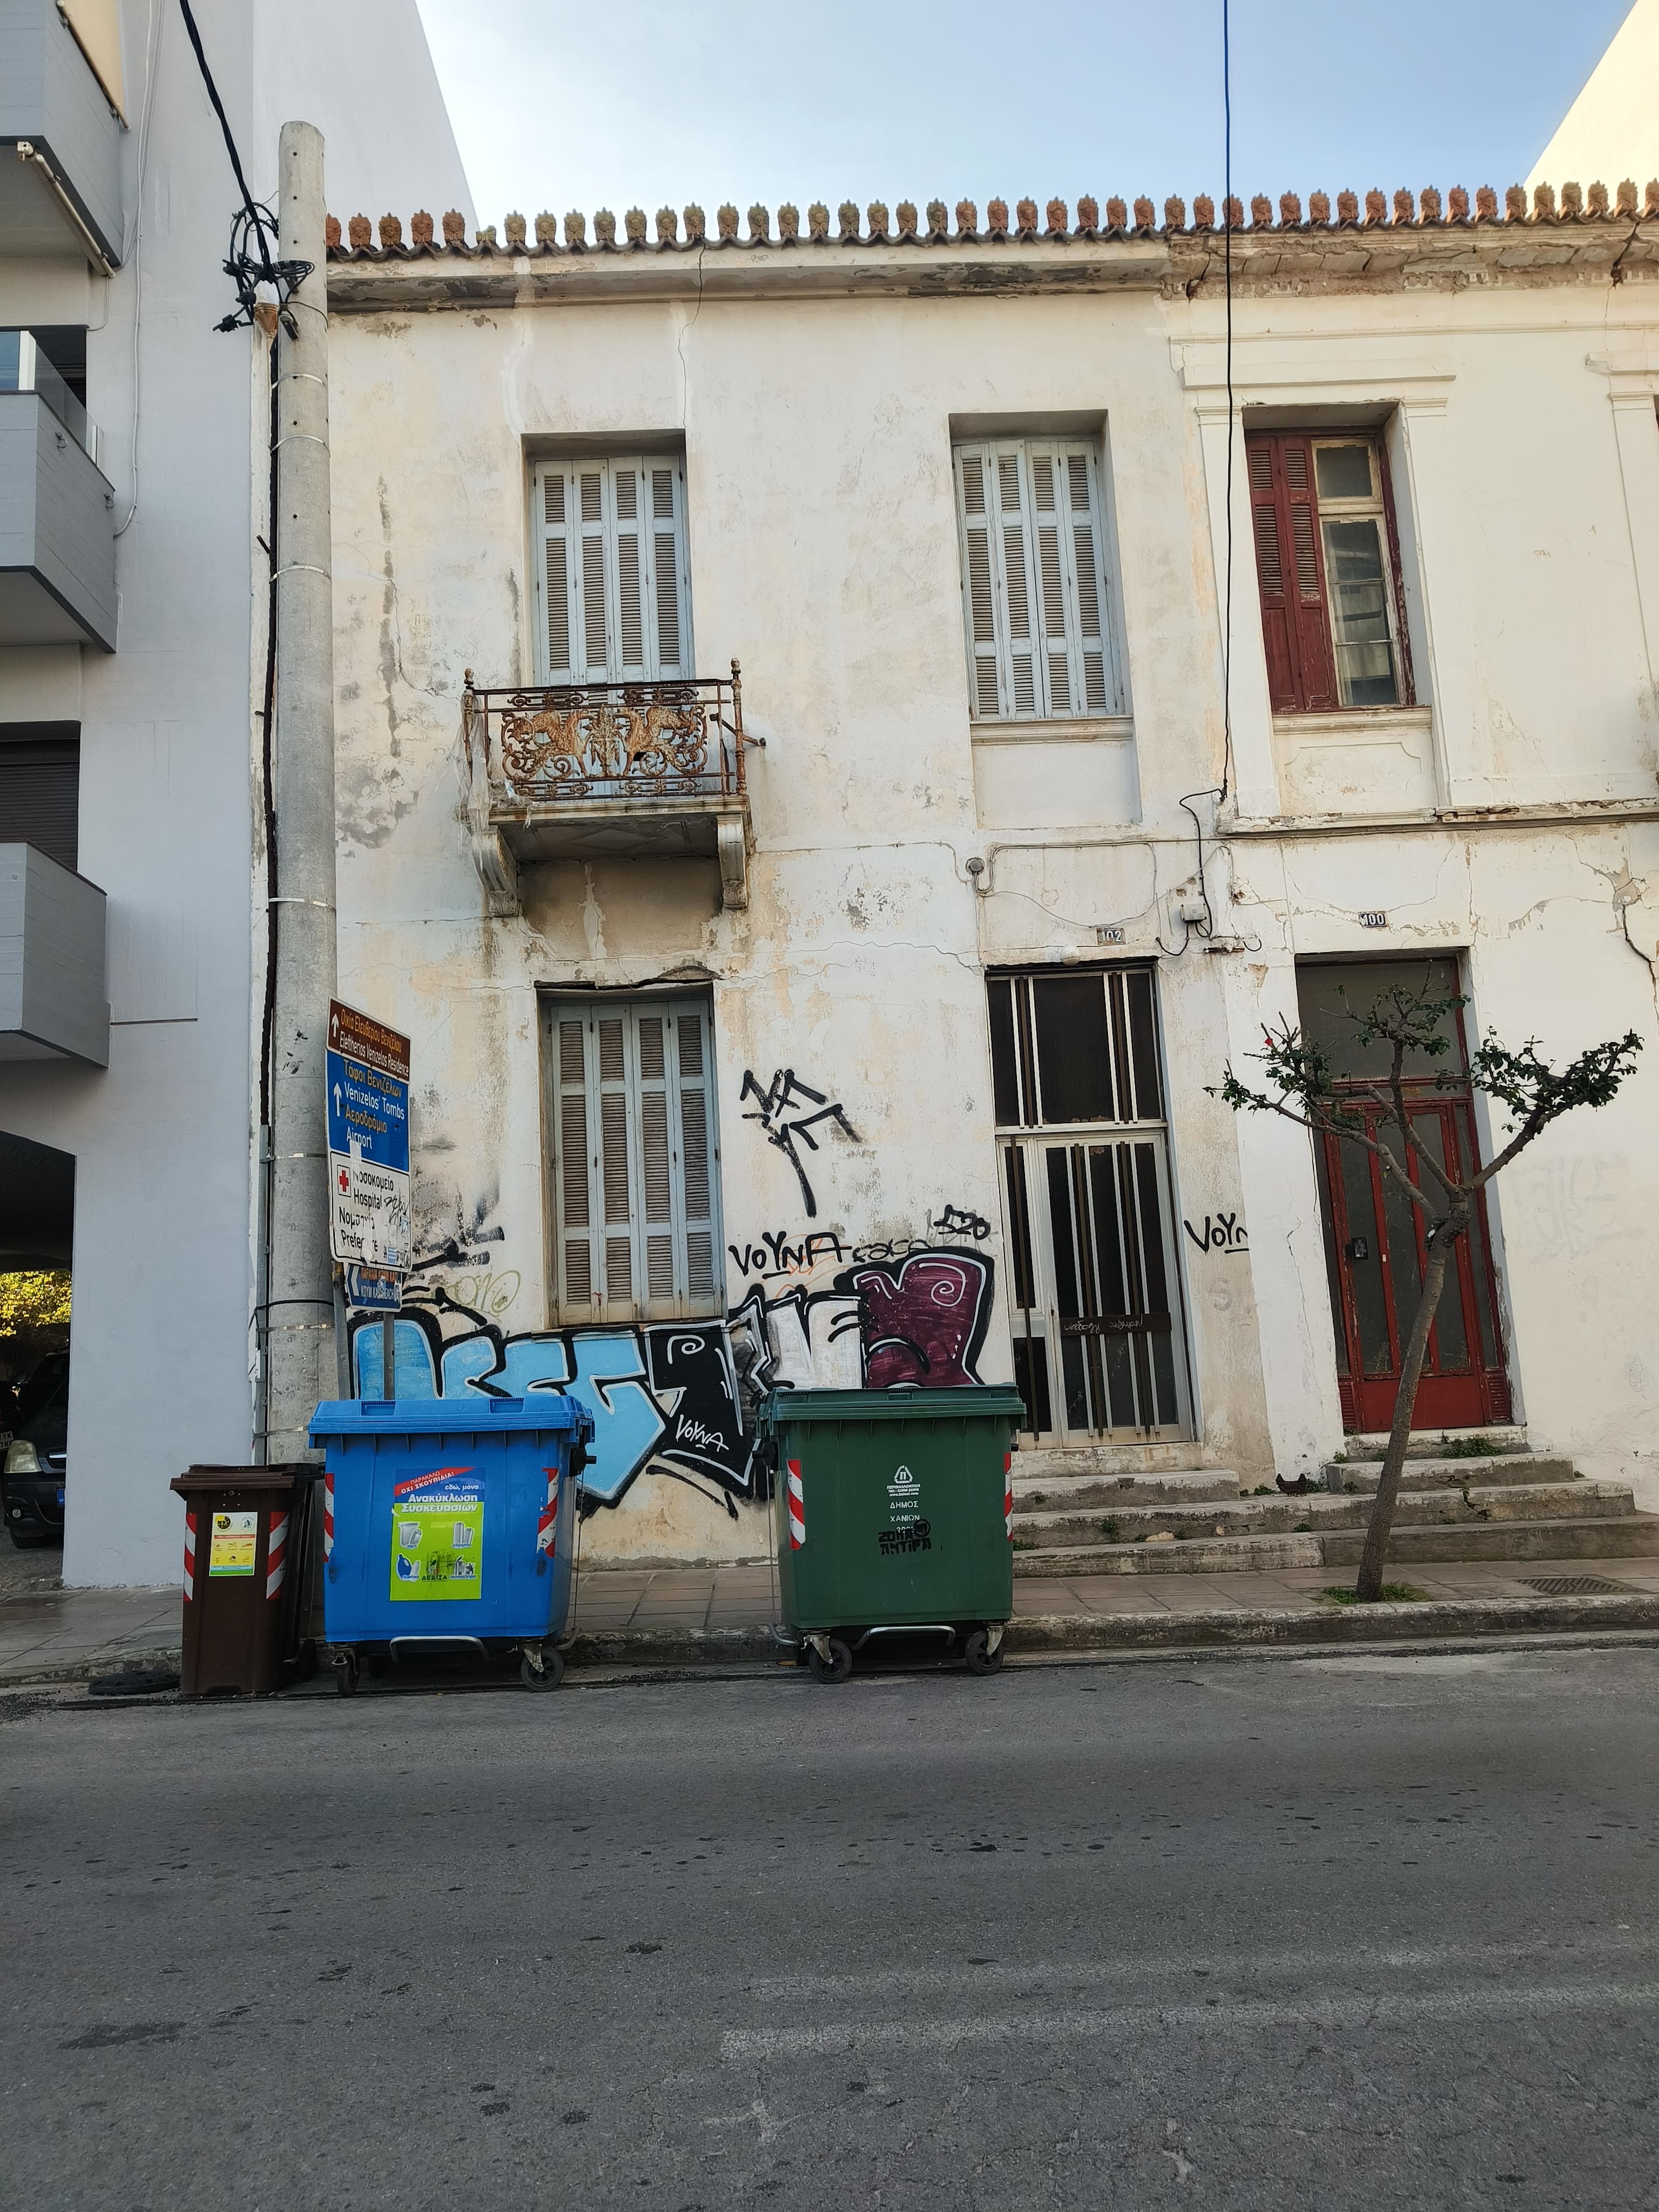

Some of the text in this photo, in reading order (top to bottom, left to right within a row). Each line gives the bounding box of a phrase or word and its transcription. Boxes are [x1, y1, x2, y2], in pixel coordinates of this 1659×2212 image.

[1364, 914, 1384, 925] 100
[1102, 930, 1122, 942] 102
[341, 1009, 402, 1053] Οικία Ελευθερίου Βενιζέλου
[340, 1031, 409, 1077] Eleftherios Venizelos Residence
[343, 1060, 402, 1098] Τάφοι Βενιζέλων
[382, 1097, 404, 1120] Tombs
[346, 1104, 387, 1135] Αεροδρόμιο
[347, 1126, 372, 1149] Airport
[354, 1188, 382, 1210] Hospital
[414, 1472, 454, 1489] ΣΚΟΥΠΙΔΙΑ!
[408, 1493, 478, 1502] Ανακύκλωση
[889, 1501, 919, 1509] ΔΗΜΟΣ
[401, 1502, 478, 1513] Συσκευασιών
[890, 1514, 920, 1522] ΧΑΝΙΩΝ
